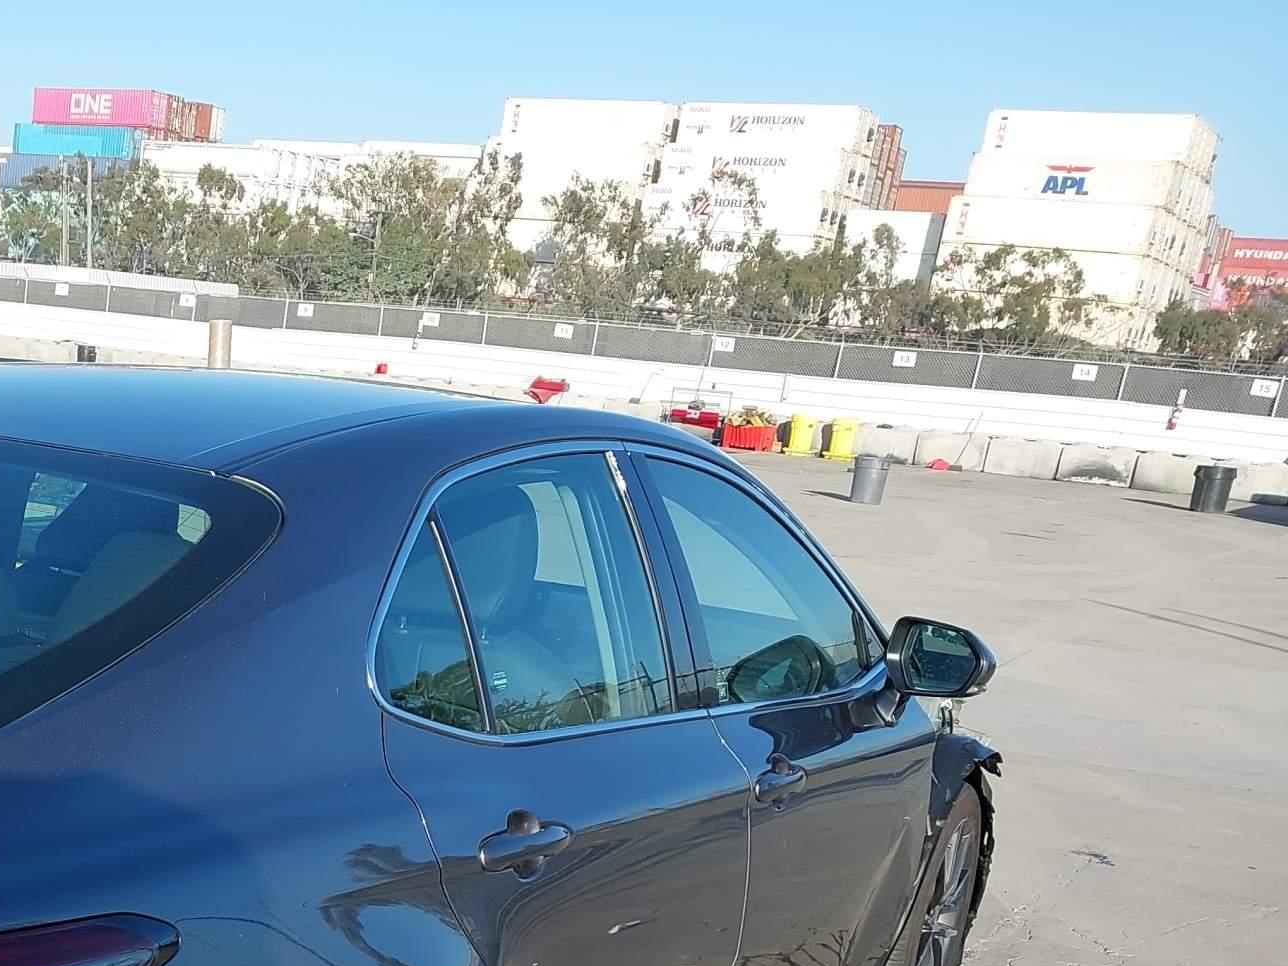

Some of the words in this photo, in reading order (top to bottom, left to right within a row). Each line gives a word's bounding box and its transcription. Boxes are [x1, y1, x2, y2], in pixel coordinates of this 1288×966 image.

[71, 93, 112, 114] ONE
[752, 115, 806, 126] HORIZON
[733, 156, 787, 167] HORIZON
[1040, 175, 1089, 196] APL
[714, 198, 768, 209] HORIZON
[720, 340, 730, 349] 12
[900, 355, 910, 363] 13
[1080, 368, 1091, 376] 14
[1259, 384, 1272, 393] 15
